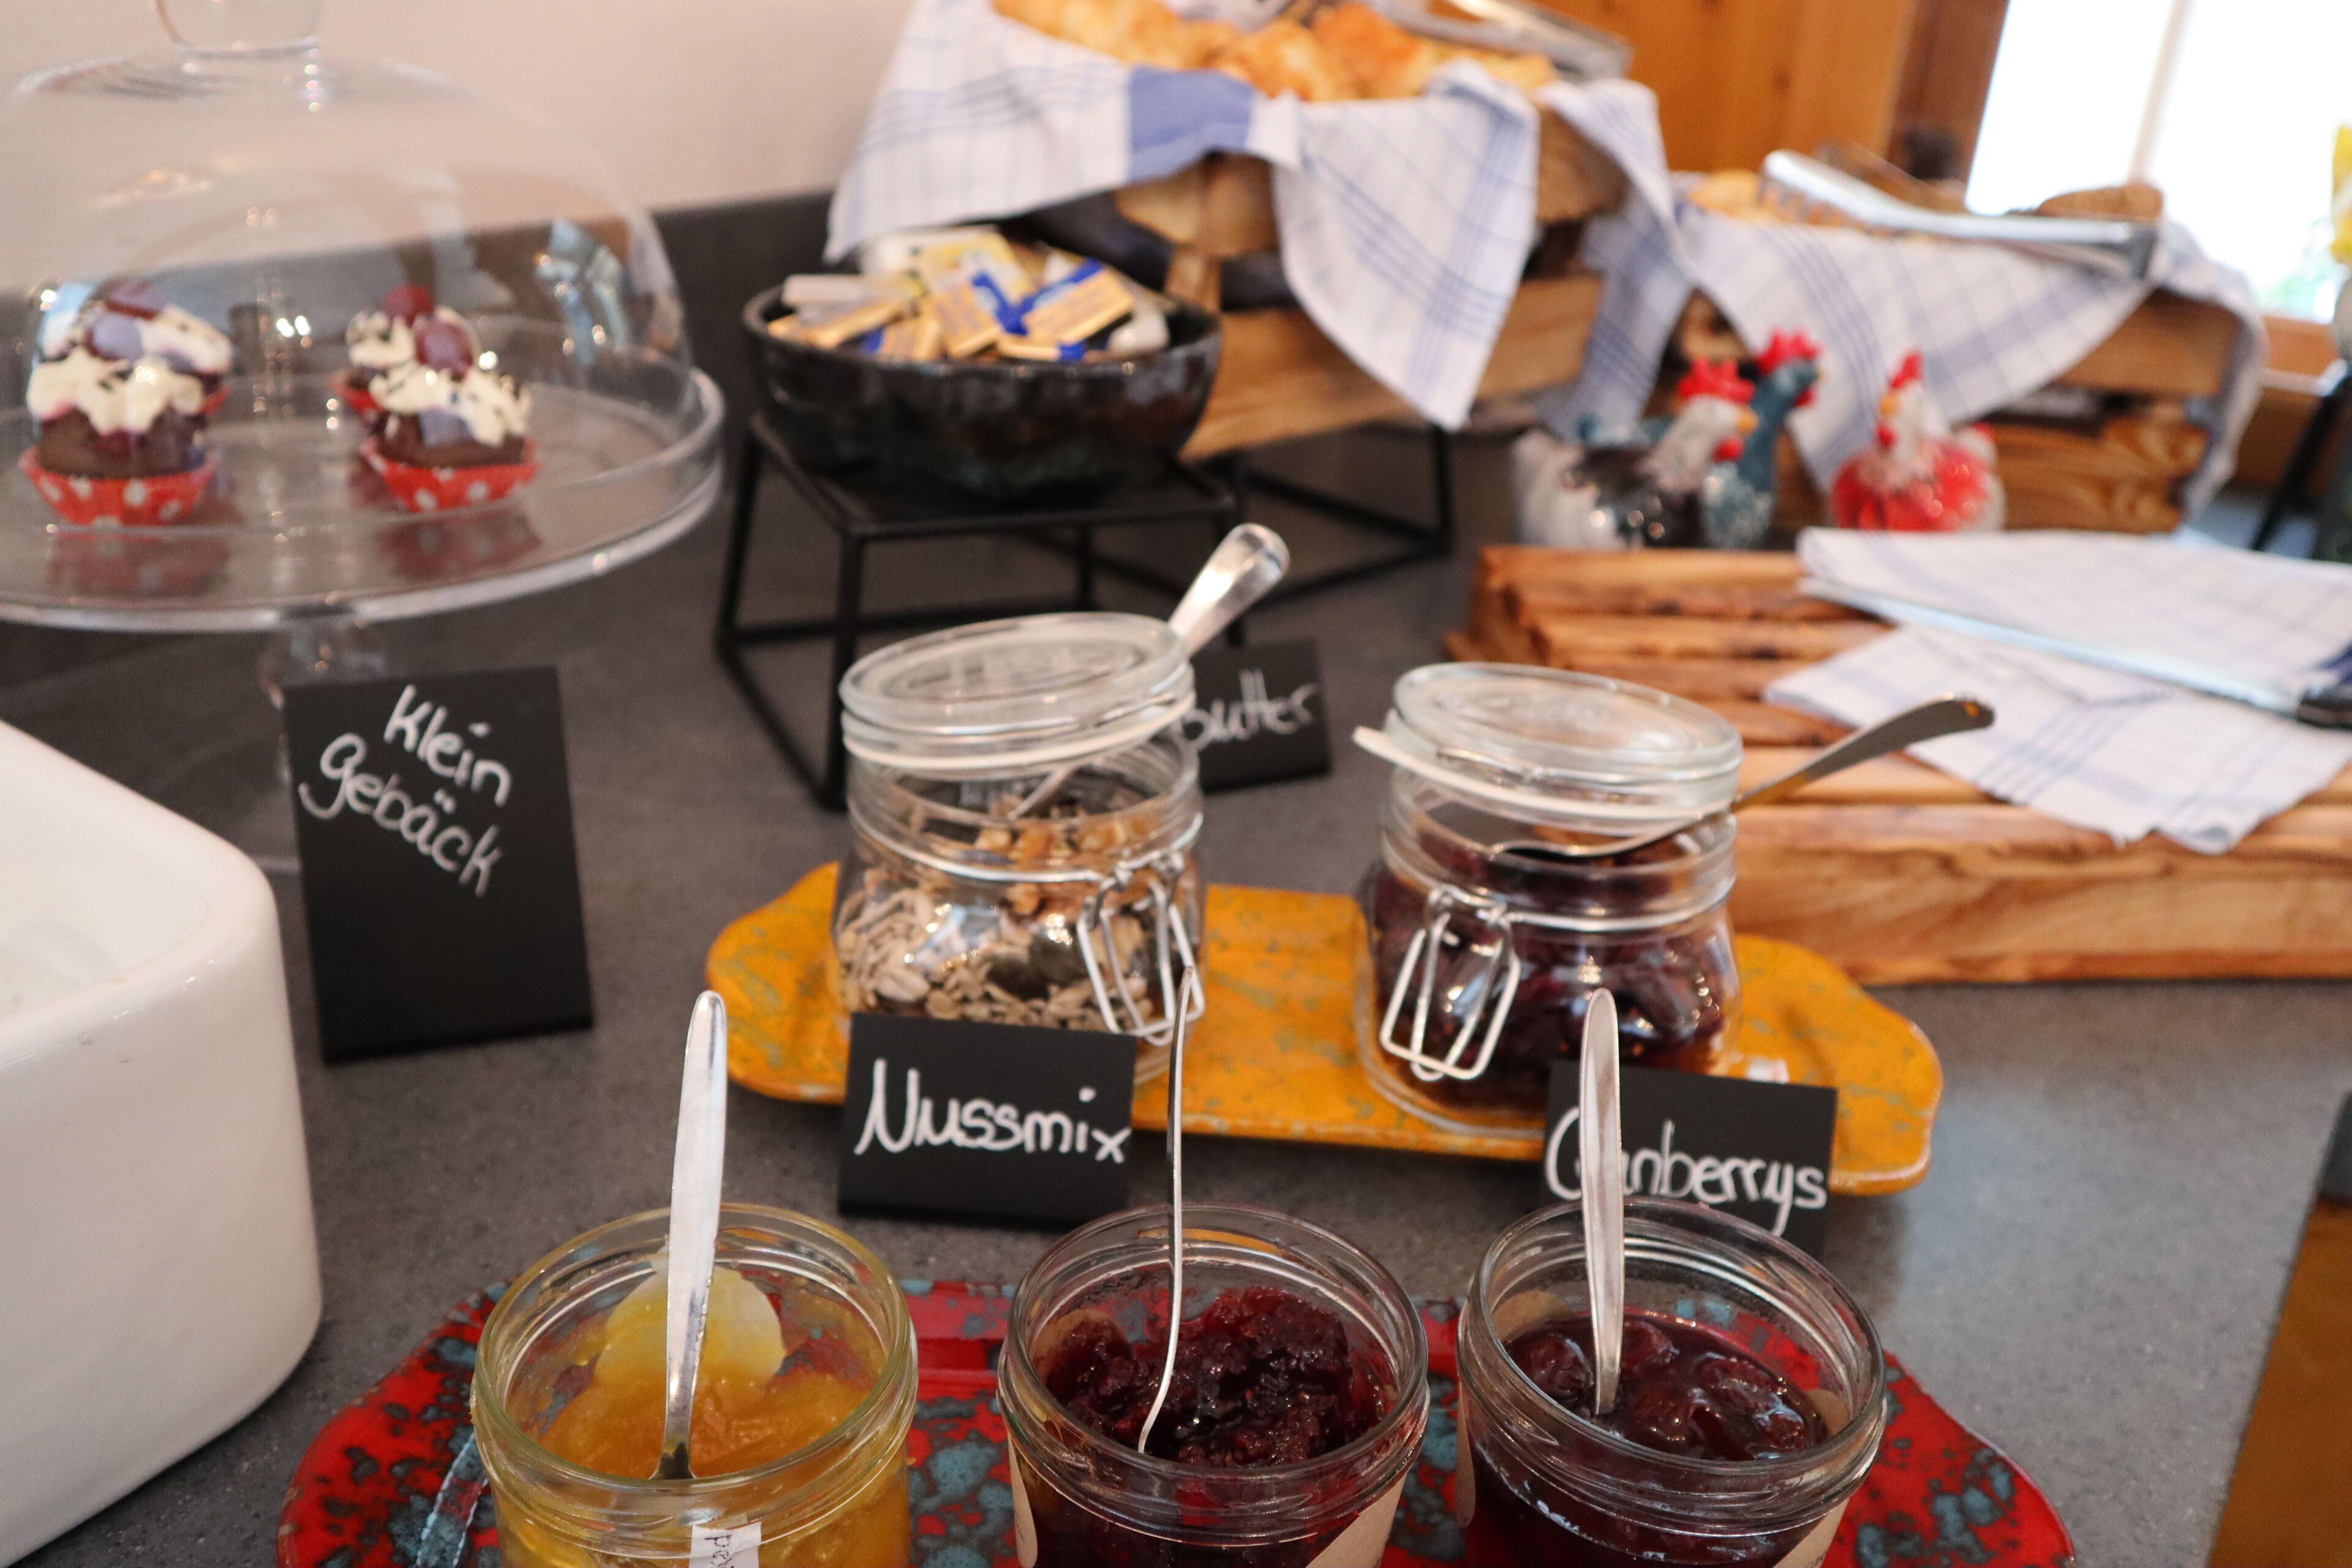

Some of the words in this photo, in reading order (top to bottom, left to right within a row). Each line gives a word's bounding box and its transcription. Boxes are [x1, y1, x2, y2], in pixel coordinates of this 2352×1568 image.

[383, 684, 512, 806] Klein
[853, 1057, 1132, 1164] Nussmix
[1545, 1104, 1828, 1237] Cnberrys
